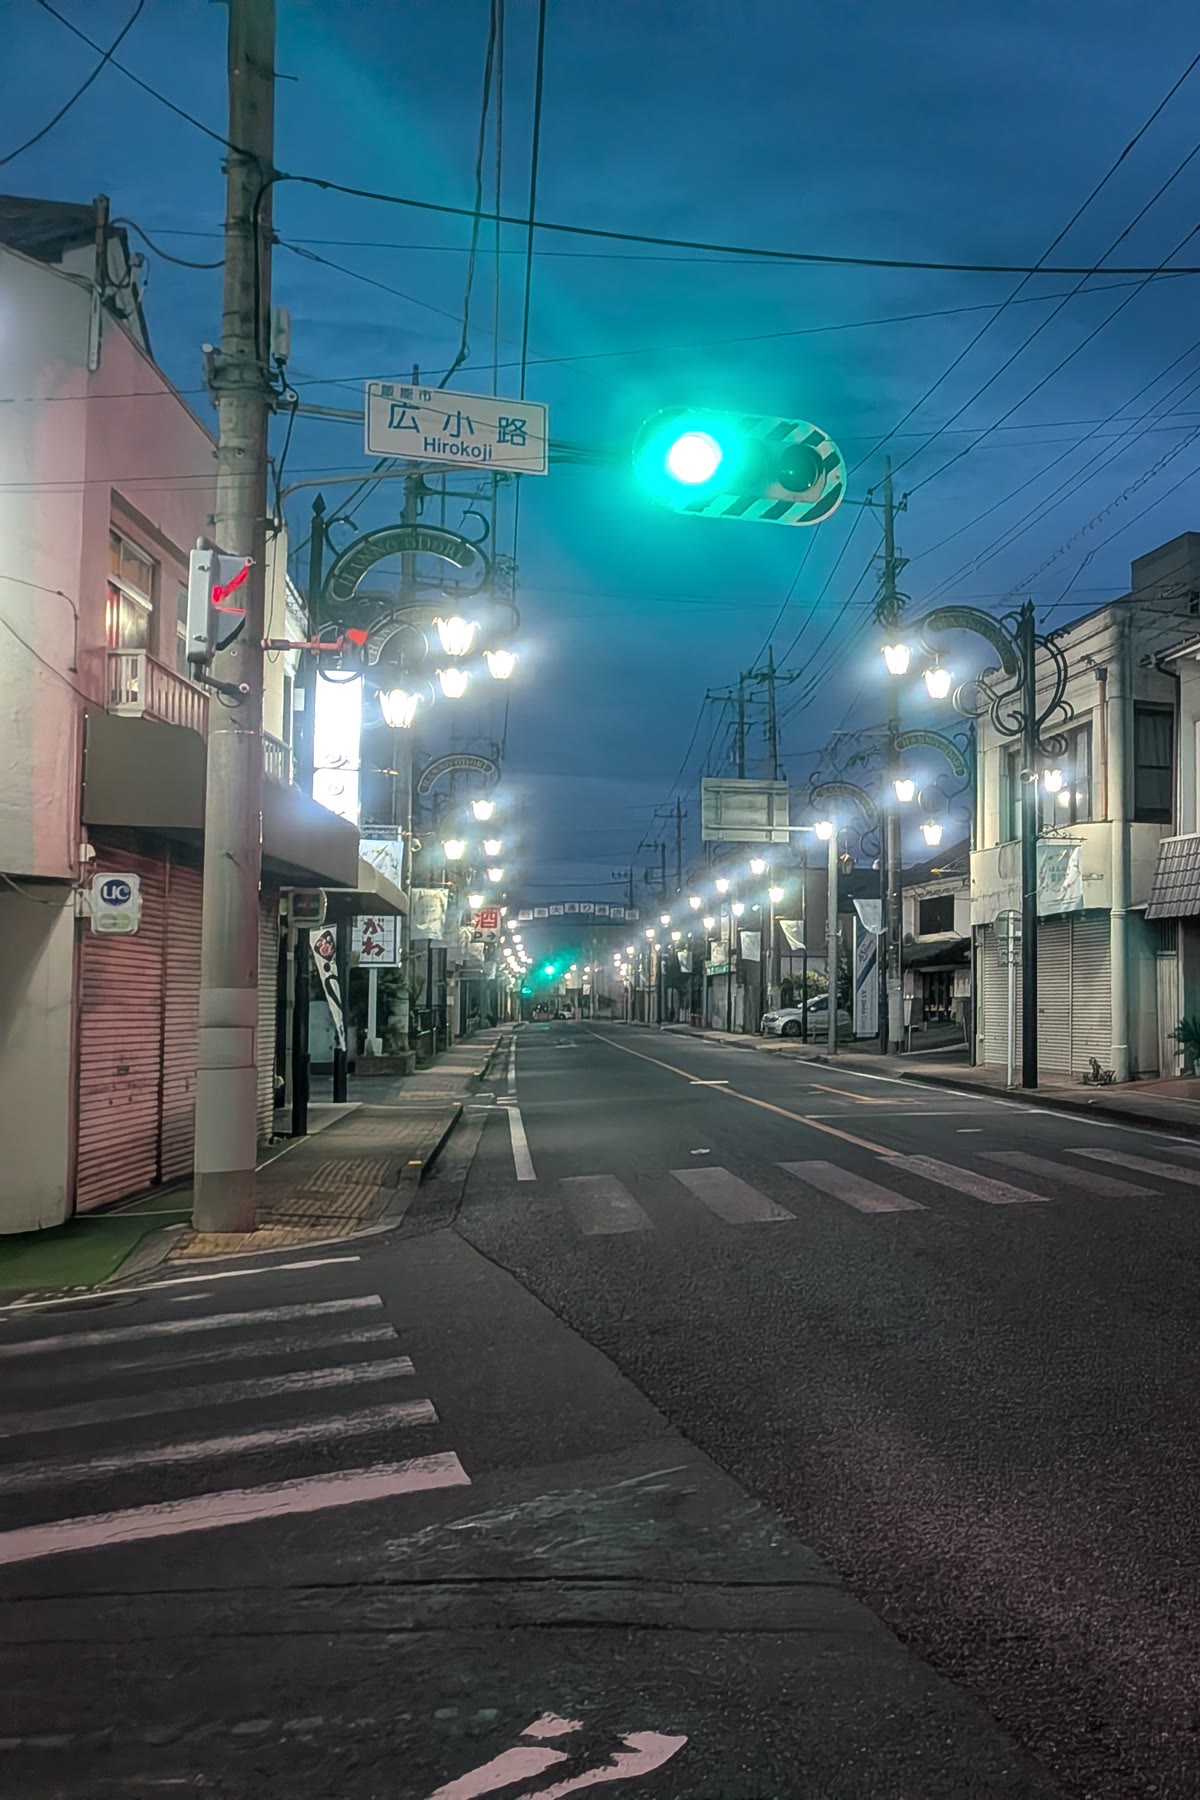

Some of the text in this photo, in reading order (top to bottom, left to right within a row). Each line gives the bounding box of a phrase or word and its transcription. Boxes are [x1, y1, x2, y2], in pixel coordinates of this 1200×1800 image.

[388, 402, 528, 447] 広小路
[423, 436, 493, 462] Hirokoji
[474, 906, 498, 929] 酒
